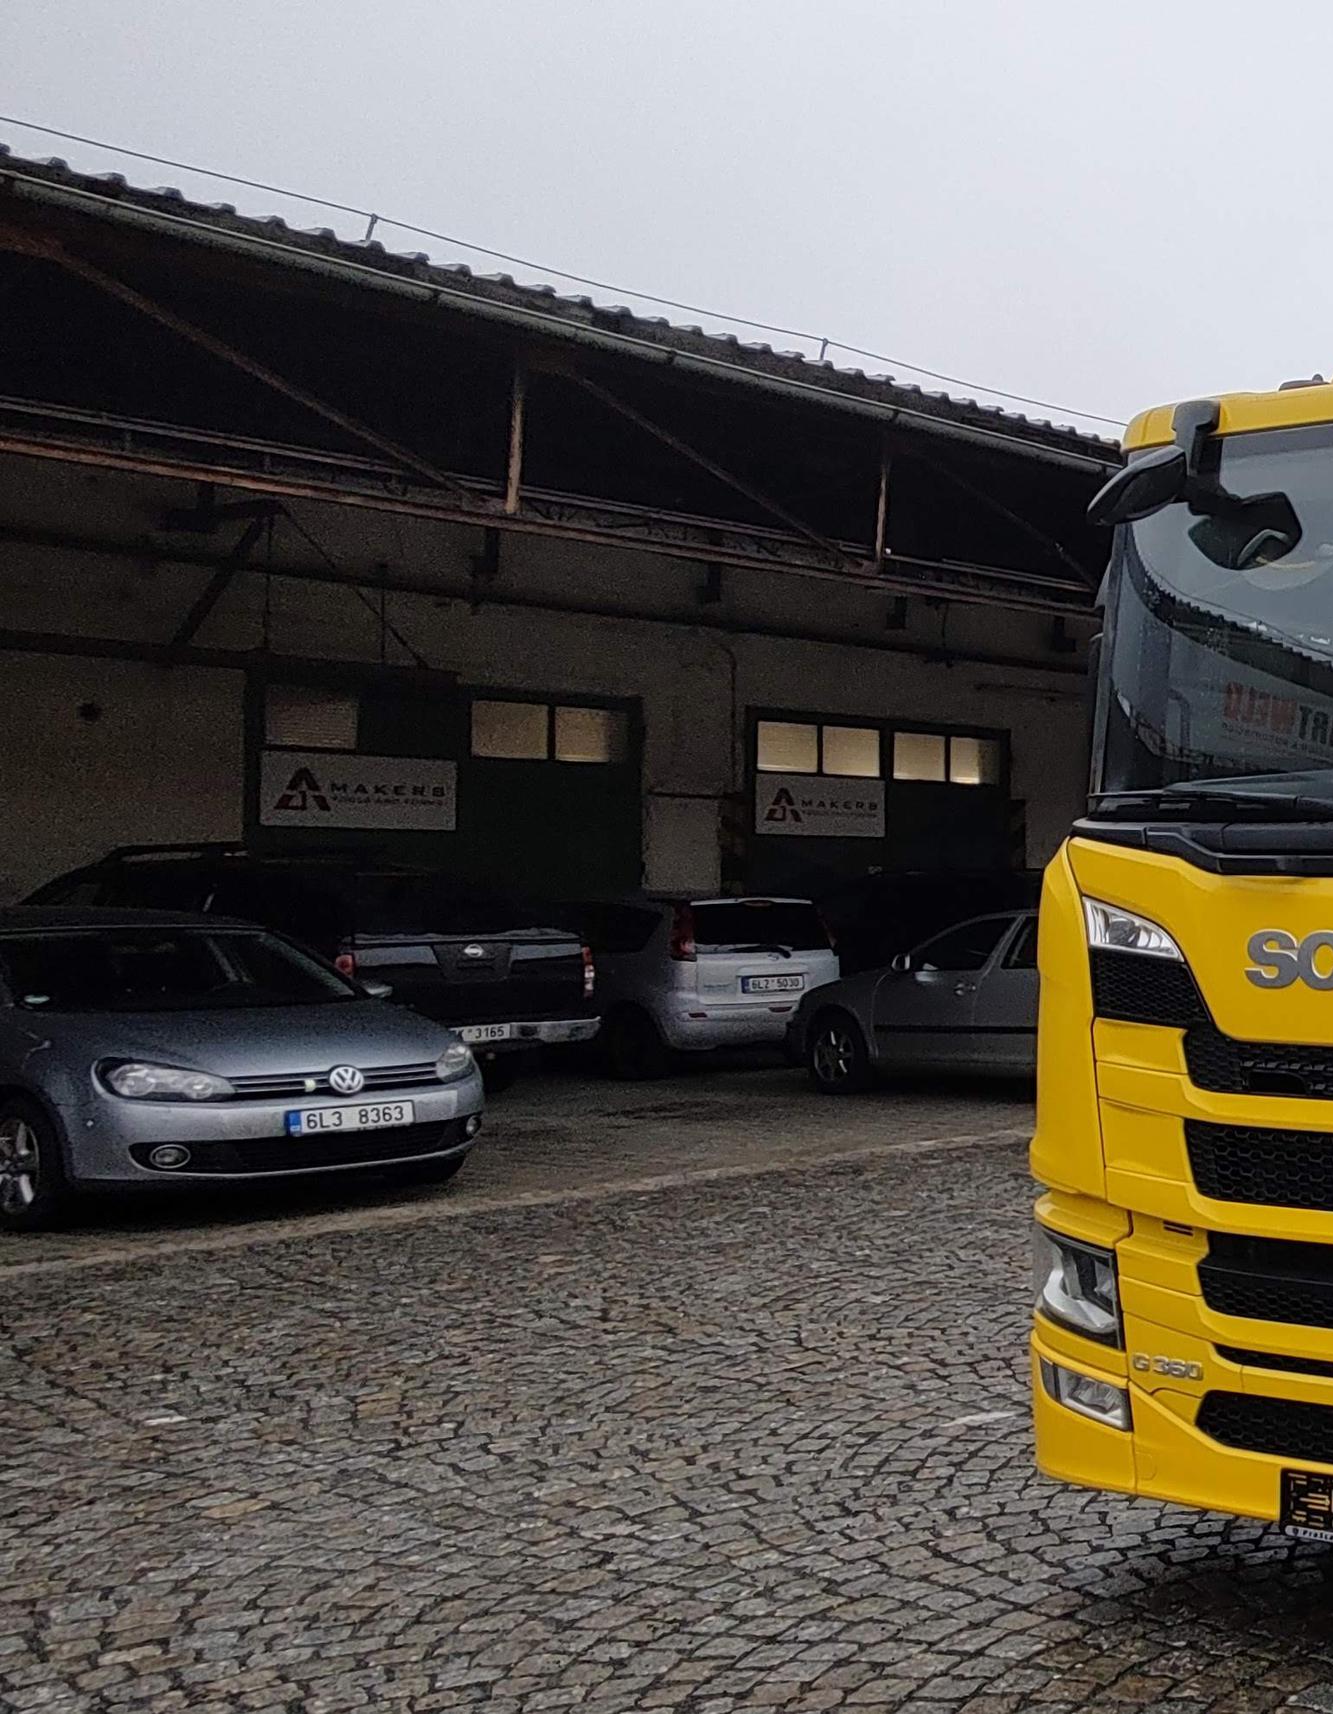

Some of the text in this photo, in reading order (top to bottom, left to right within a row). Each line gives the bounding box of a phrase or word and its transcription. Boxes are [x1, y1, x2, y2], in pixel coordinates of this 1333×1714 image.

[475, 1026, 505, 1039] 3165
[306, 1105, 404, 1129] 6L3 8363
[1133, 1352, 1203, 1381] G 360
